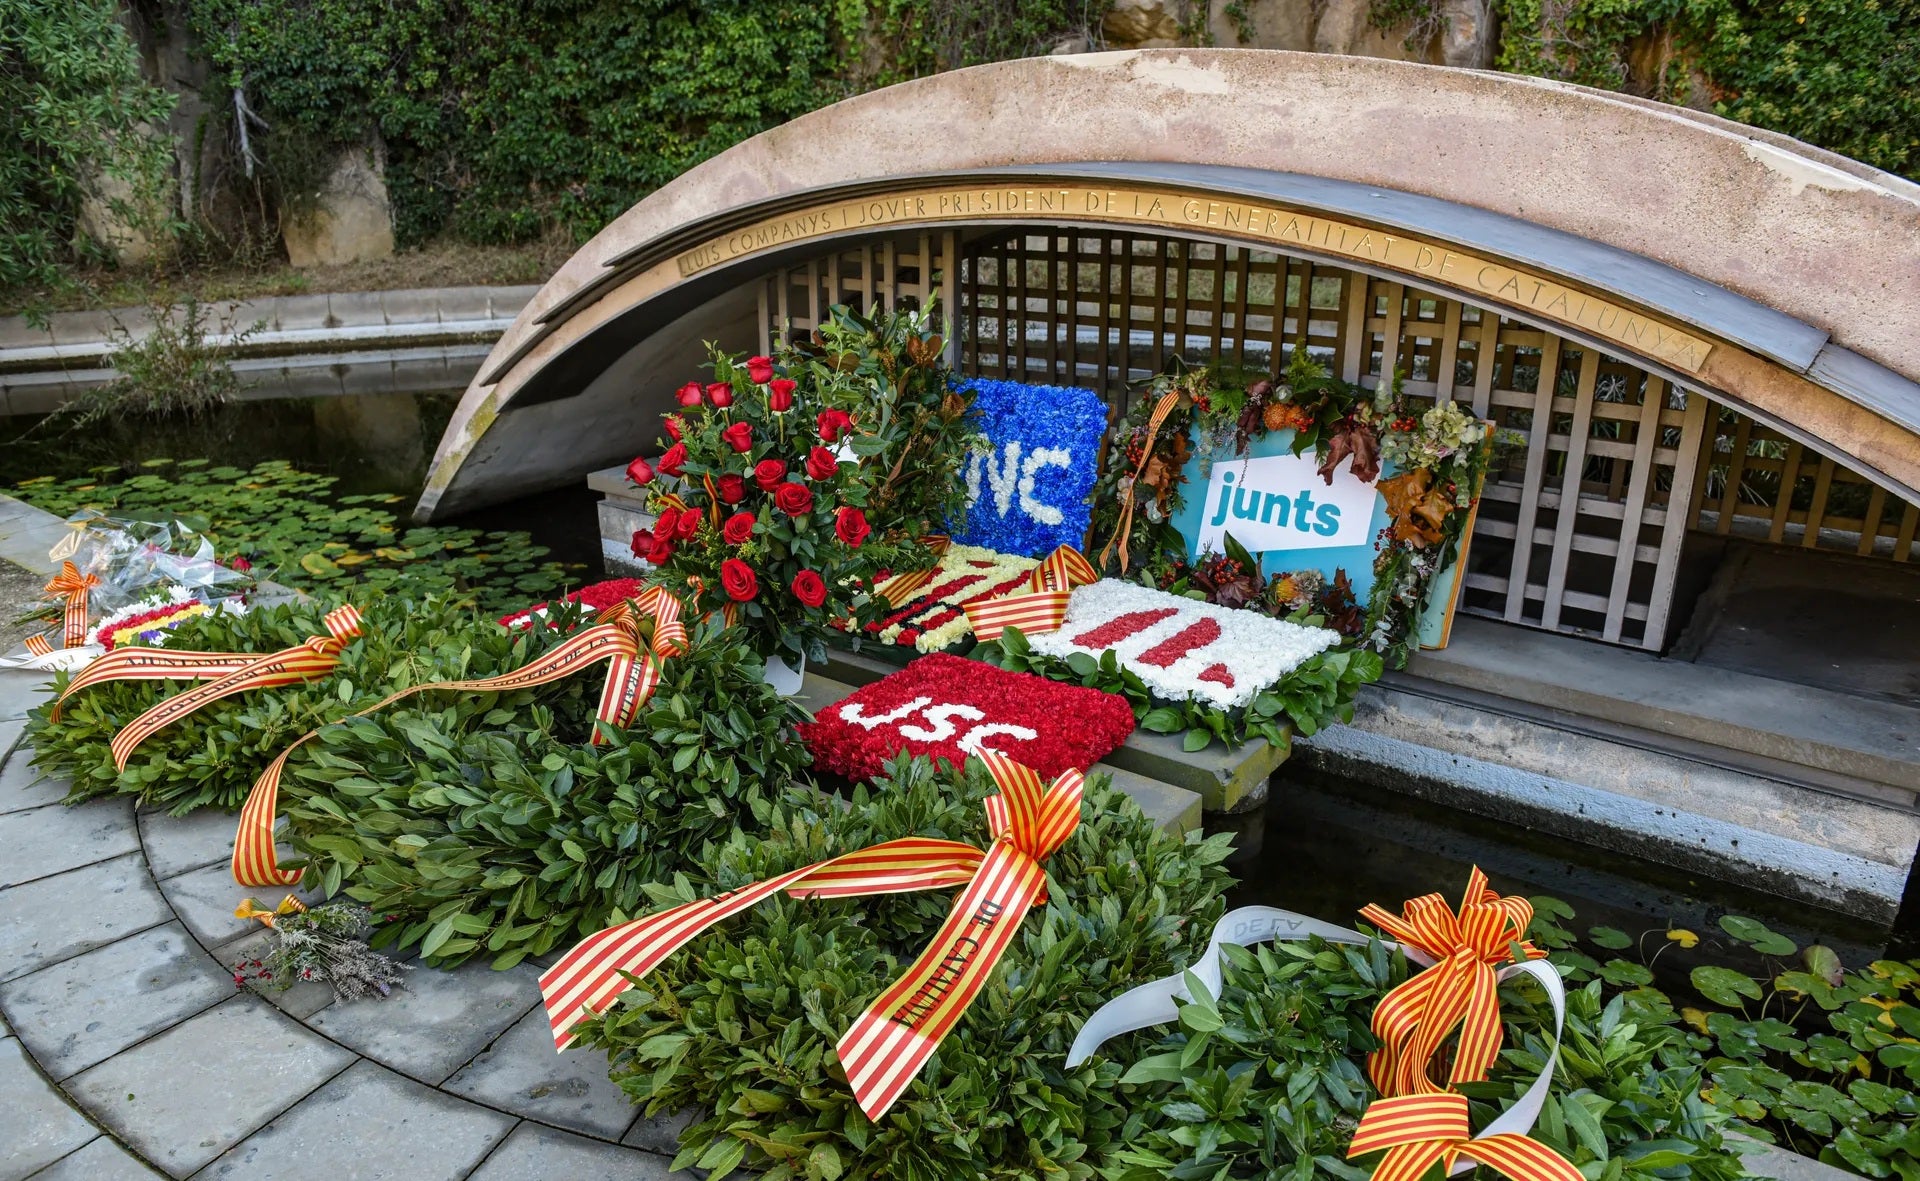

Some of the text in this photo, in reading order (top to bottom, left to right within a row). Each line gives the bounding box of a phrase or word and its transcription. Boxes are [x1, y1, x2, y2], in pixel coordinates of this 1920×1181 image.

[729, 212, 831, 254] COMPANYS
[860, 197, 926, 223] JOVER
[939, 191, 1069, 214] PRESIDENT
[1085, 192, 1117, 213] DE
[1134, 195, 1165, 218] LA
[1183, 200, 1397, 259] GENERALITAT
[1414, 246, 1458, 275] DE
[1478, 266, 1698, 368] CATALUNYA
[955, 432, 1072, 526] NC
[1211, 471, 1341, 536] junts
[493, 663, 557, 687] GOVERN
[564, 648, 581, 664] DE
[589, 637, 609, 649] LA
[890, 898, 1004, 1030] DE CATALUNYA
